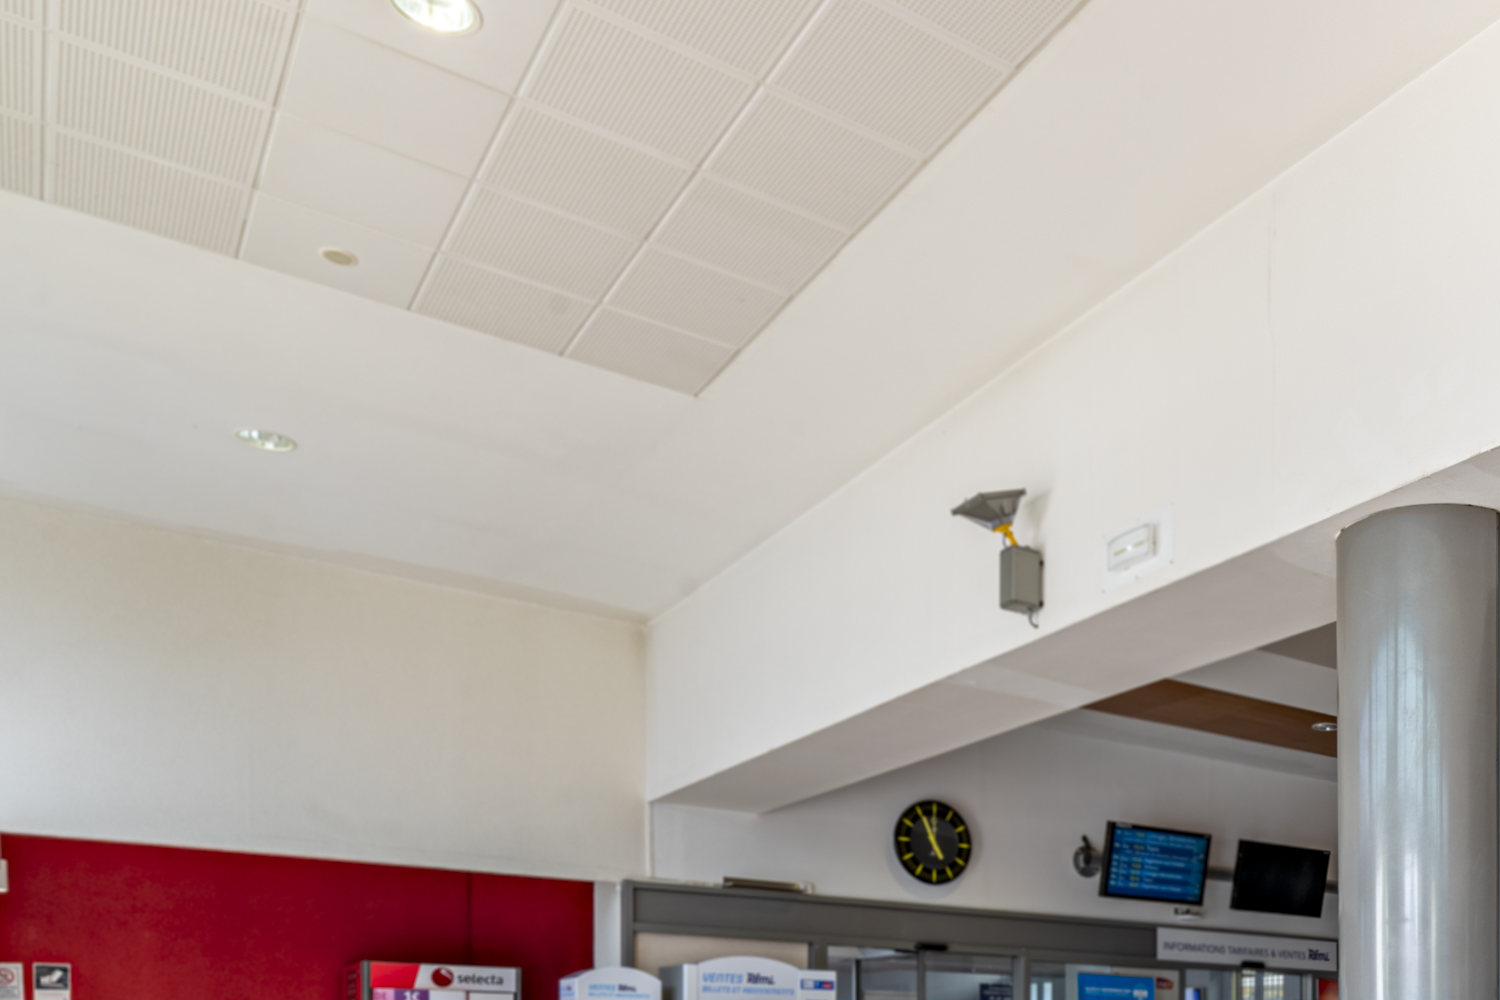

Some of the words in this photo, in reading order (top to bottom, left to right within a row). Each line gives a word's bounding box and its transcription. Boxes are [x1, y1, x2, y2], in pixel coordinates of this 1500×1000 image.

[1163, 941, 1226, 954] INFORMATIONS
[1228, 945, 1269, 958] TARIFAIRES
[1278, 950, 1306, 960] VENTES
[457, 973, 504, 986] selecta
